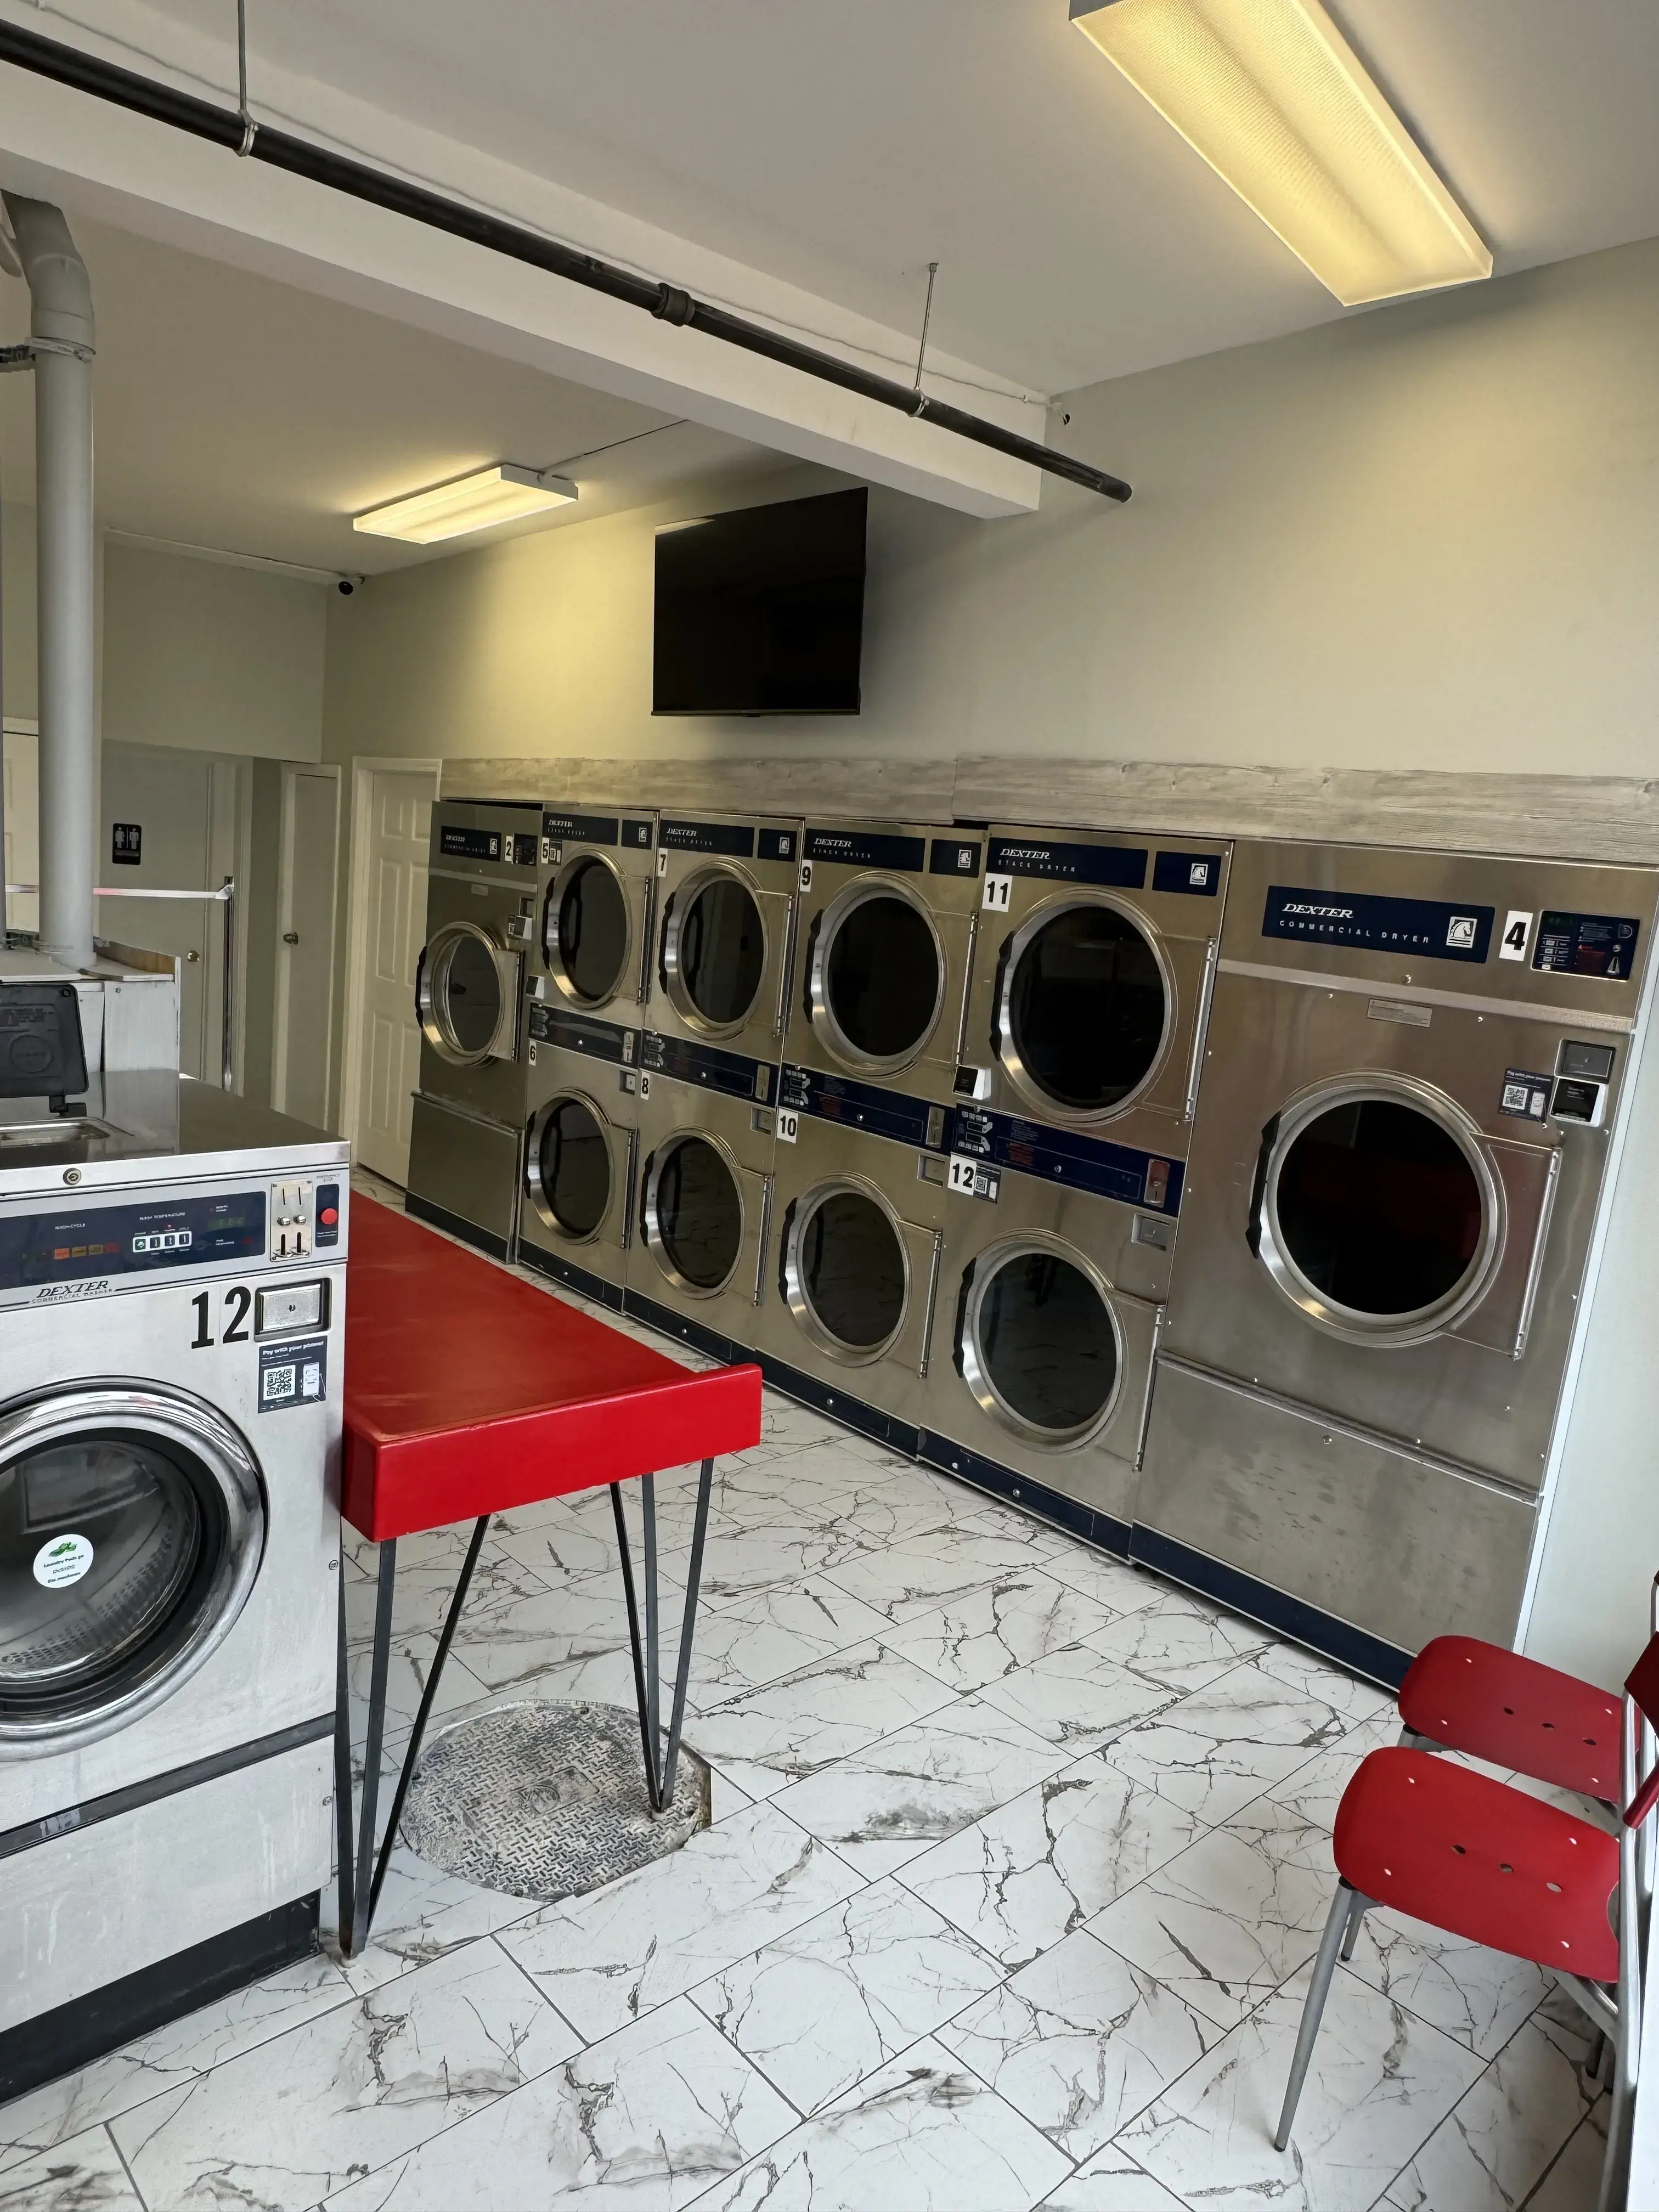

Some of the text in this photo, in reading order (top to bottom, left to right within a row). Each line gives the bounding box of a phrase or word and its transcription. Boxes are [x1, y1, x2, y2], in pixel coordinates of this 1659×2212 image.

[667, 828, 697, 837] DEXTER
[506, 840, 512, 856] 2
[542, 843, 548, 859] 5
[814, 838, 851, 848] DEXTER
[659, 854, 667, 871] 7
[1000, 848, 1051, 860] DEXTER
[802, 866, 811, 886] 9
[987, 881, 1009, 905] 11
[1282, 904, 1354, 919] DEXTER
[1279, 920, 1429, 944] COMMERCIAL DRYER
[1504, 922, 1526, 951] 4
[529, 1047, 536, 1061] 6
[641, 1077, 648, 1094] 8
[780, 1115, 797, 1137] 10
[952, 1163, 974, 1189] 12
[36, 1280, 109, 1298] DEXTER
[191, 1286, 252, 1350] 12
